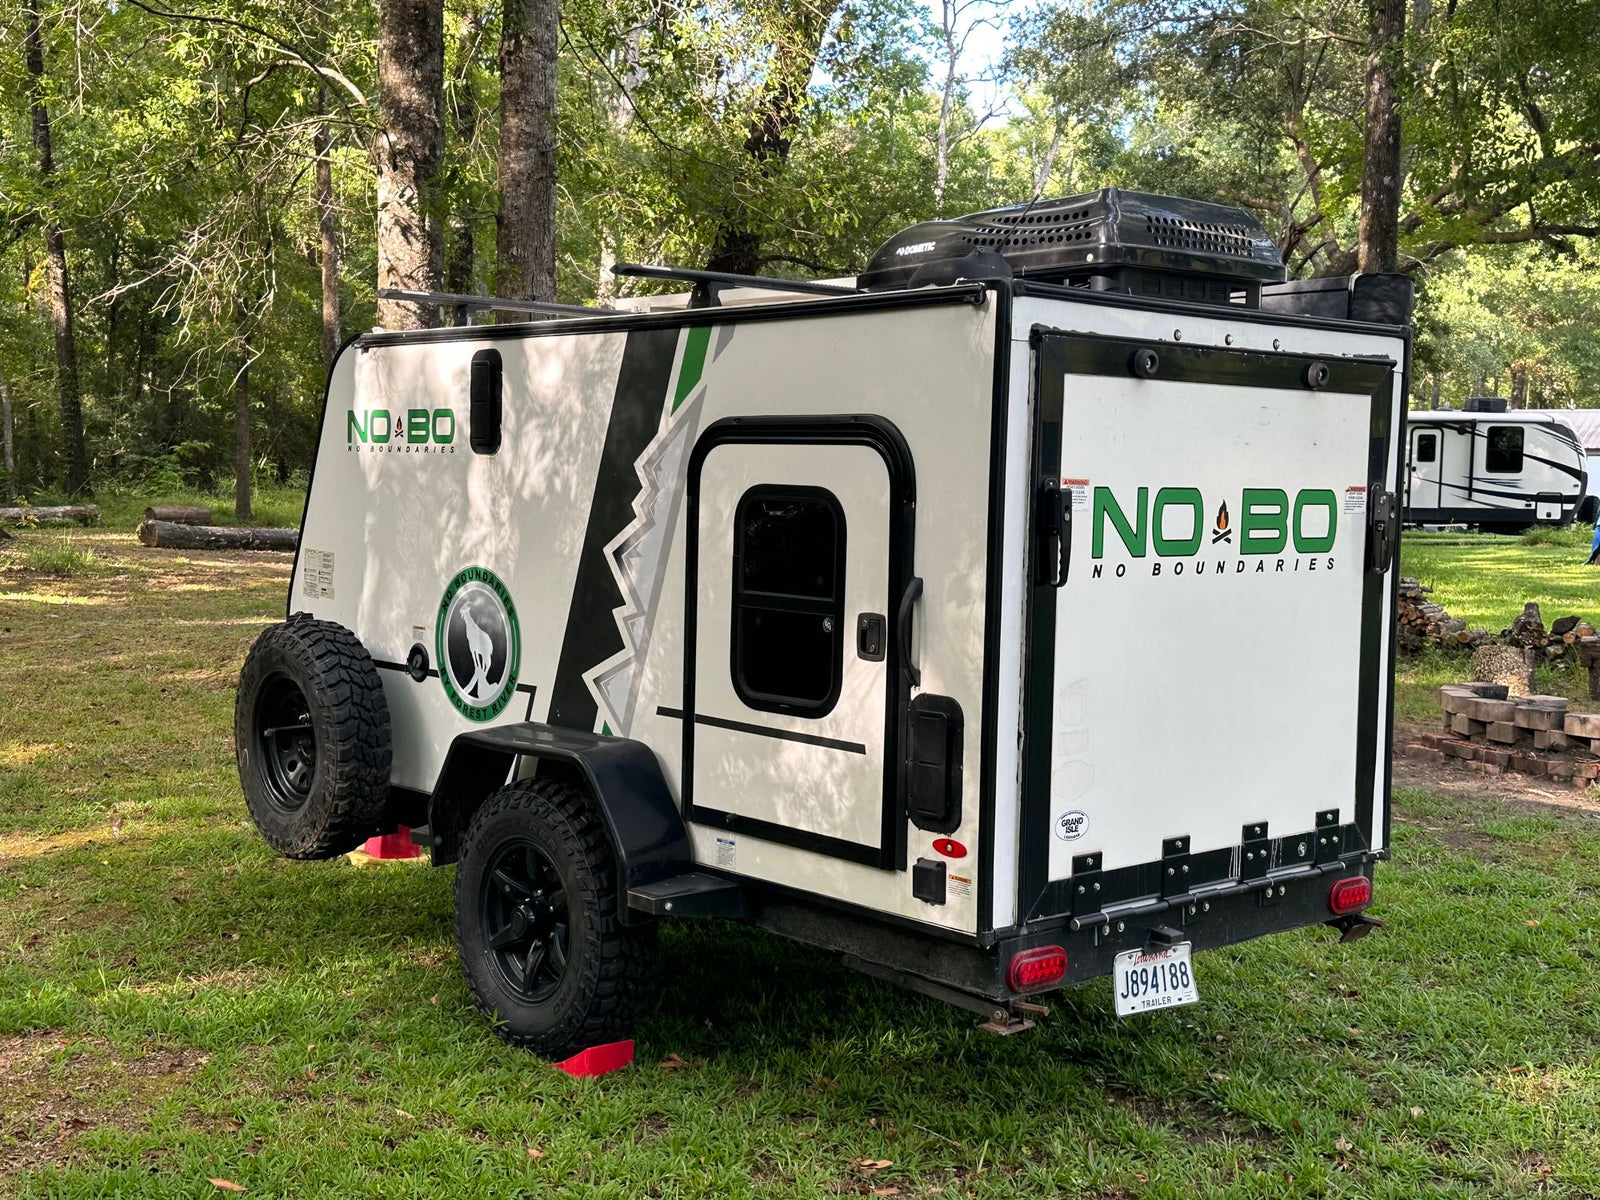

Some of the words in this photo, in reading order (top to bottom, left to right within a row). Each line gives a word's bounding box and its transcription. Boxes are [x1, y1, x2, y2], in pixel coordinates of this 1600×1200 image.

[904, 241, 936, 256] DOMETIC
[347, 409, 392, 444] NO
[407, 408, 456, 444] BO
[347, 445, 361, 453] NO
[369, 445, 455, 454] BOUNDARIES
[1091, 486, 1204, 559] NO
[1239, 488, 1338, 555] BO
[1091, 563, 1127, 579] NO
[1151, 557, 1335, 577] BOUNDARIES
[441, 590, 453, 611] NO
[454, 569, 514, 617] BOUNDARIES
[450, 691, 488, 719] FOREST
[491, 674, 516, 715] RIVER
[1061, 817, 1084, 827] GRAND
[1065, 825, 1080, 834] ISLE
[1121, 960, 1190, 1000] J894188
[1141, 995, 1172, 1009] TRAILER
